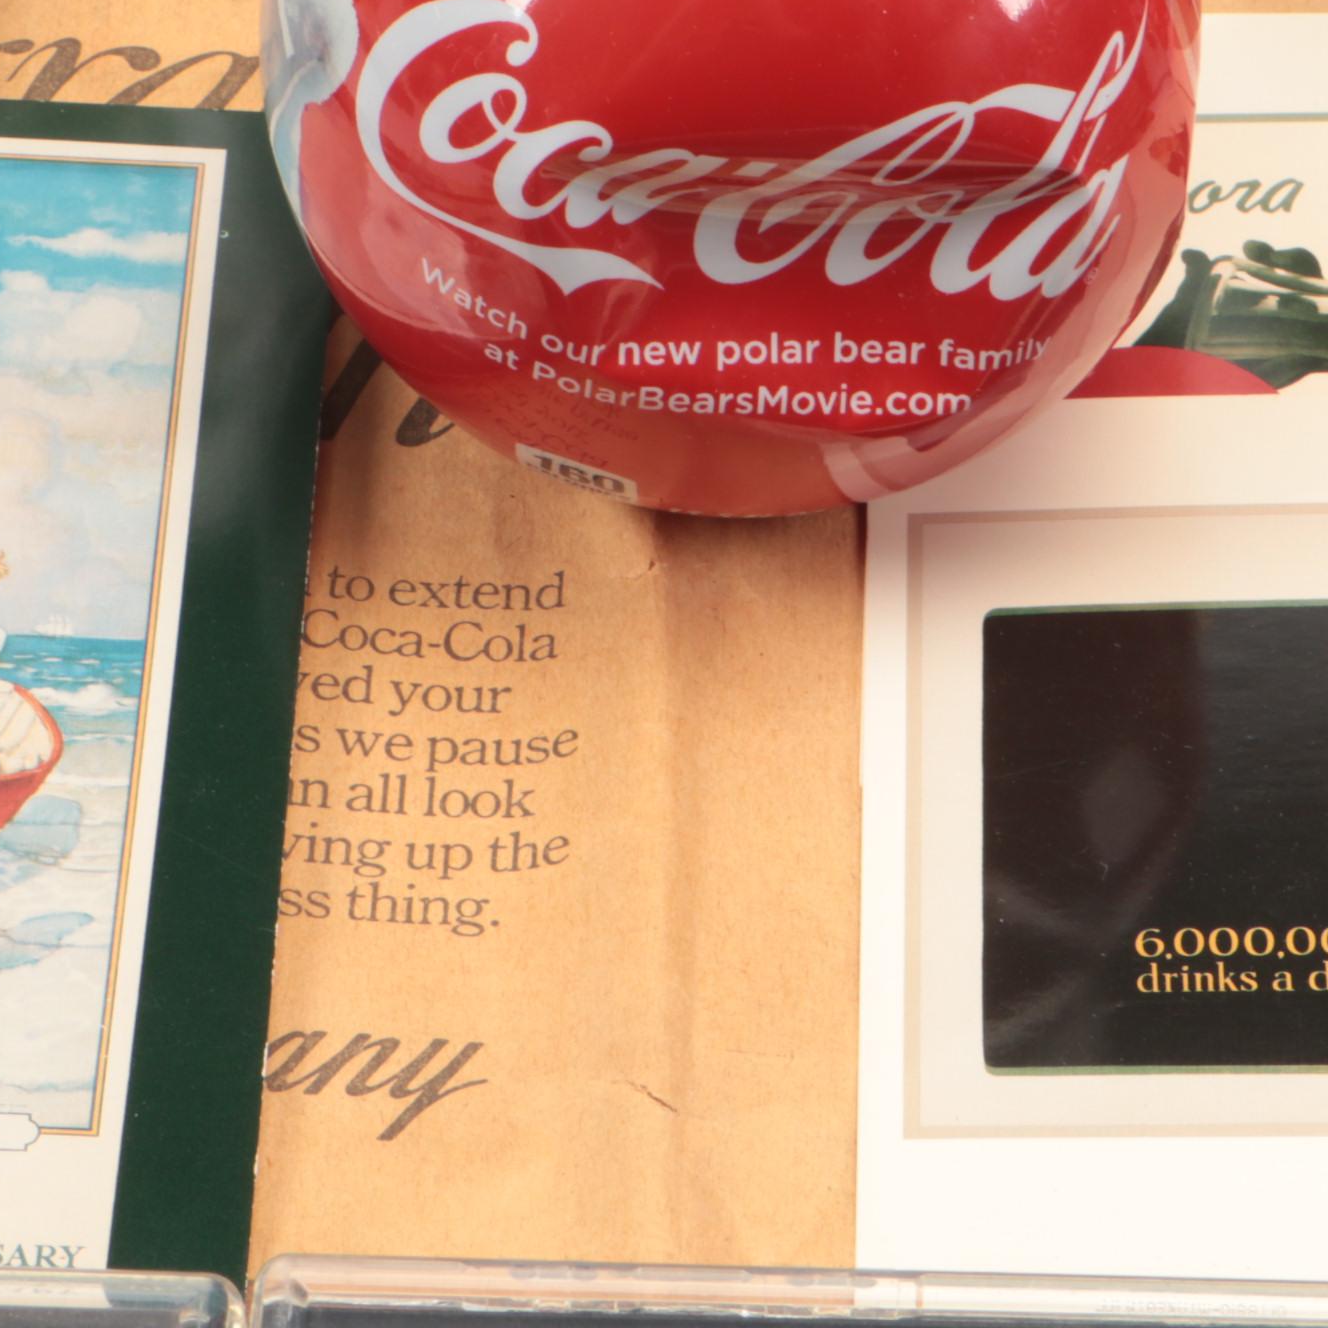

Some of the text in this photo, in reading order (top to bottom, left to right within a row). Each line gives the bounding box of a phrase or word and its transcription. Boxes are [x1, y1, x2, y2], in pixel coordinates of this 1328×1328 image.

[421, 257, 1050, 374] Watch our new polar bear family
[483, 340, 972, 418] at PolarBearsMovie.com
[533, 453, 625, 494] 160
[327, 564, 567, 611] to extend
[301, 609, 559, 662] Coca-Cola
[388, 681, 512, 717] your
[336, 725, 414, 762] we
[426, 727, 580, 773] pause
[346, 773, 408, 816] all
[423, 776, 536, 819] look
[405, 836, 474, 880] up
[488, 830, 571, 873] the
[346, 882, 501, 938] thing.
[1136, 961, 1259, 993] drinks
[1272, 970, 1296, 992] a
